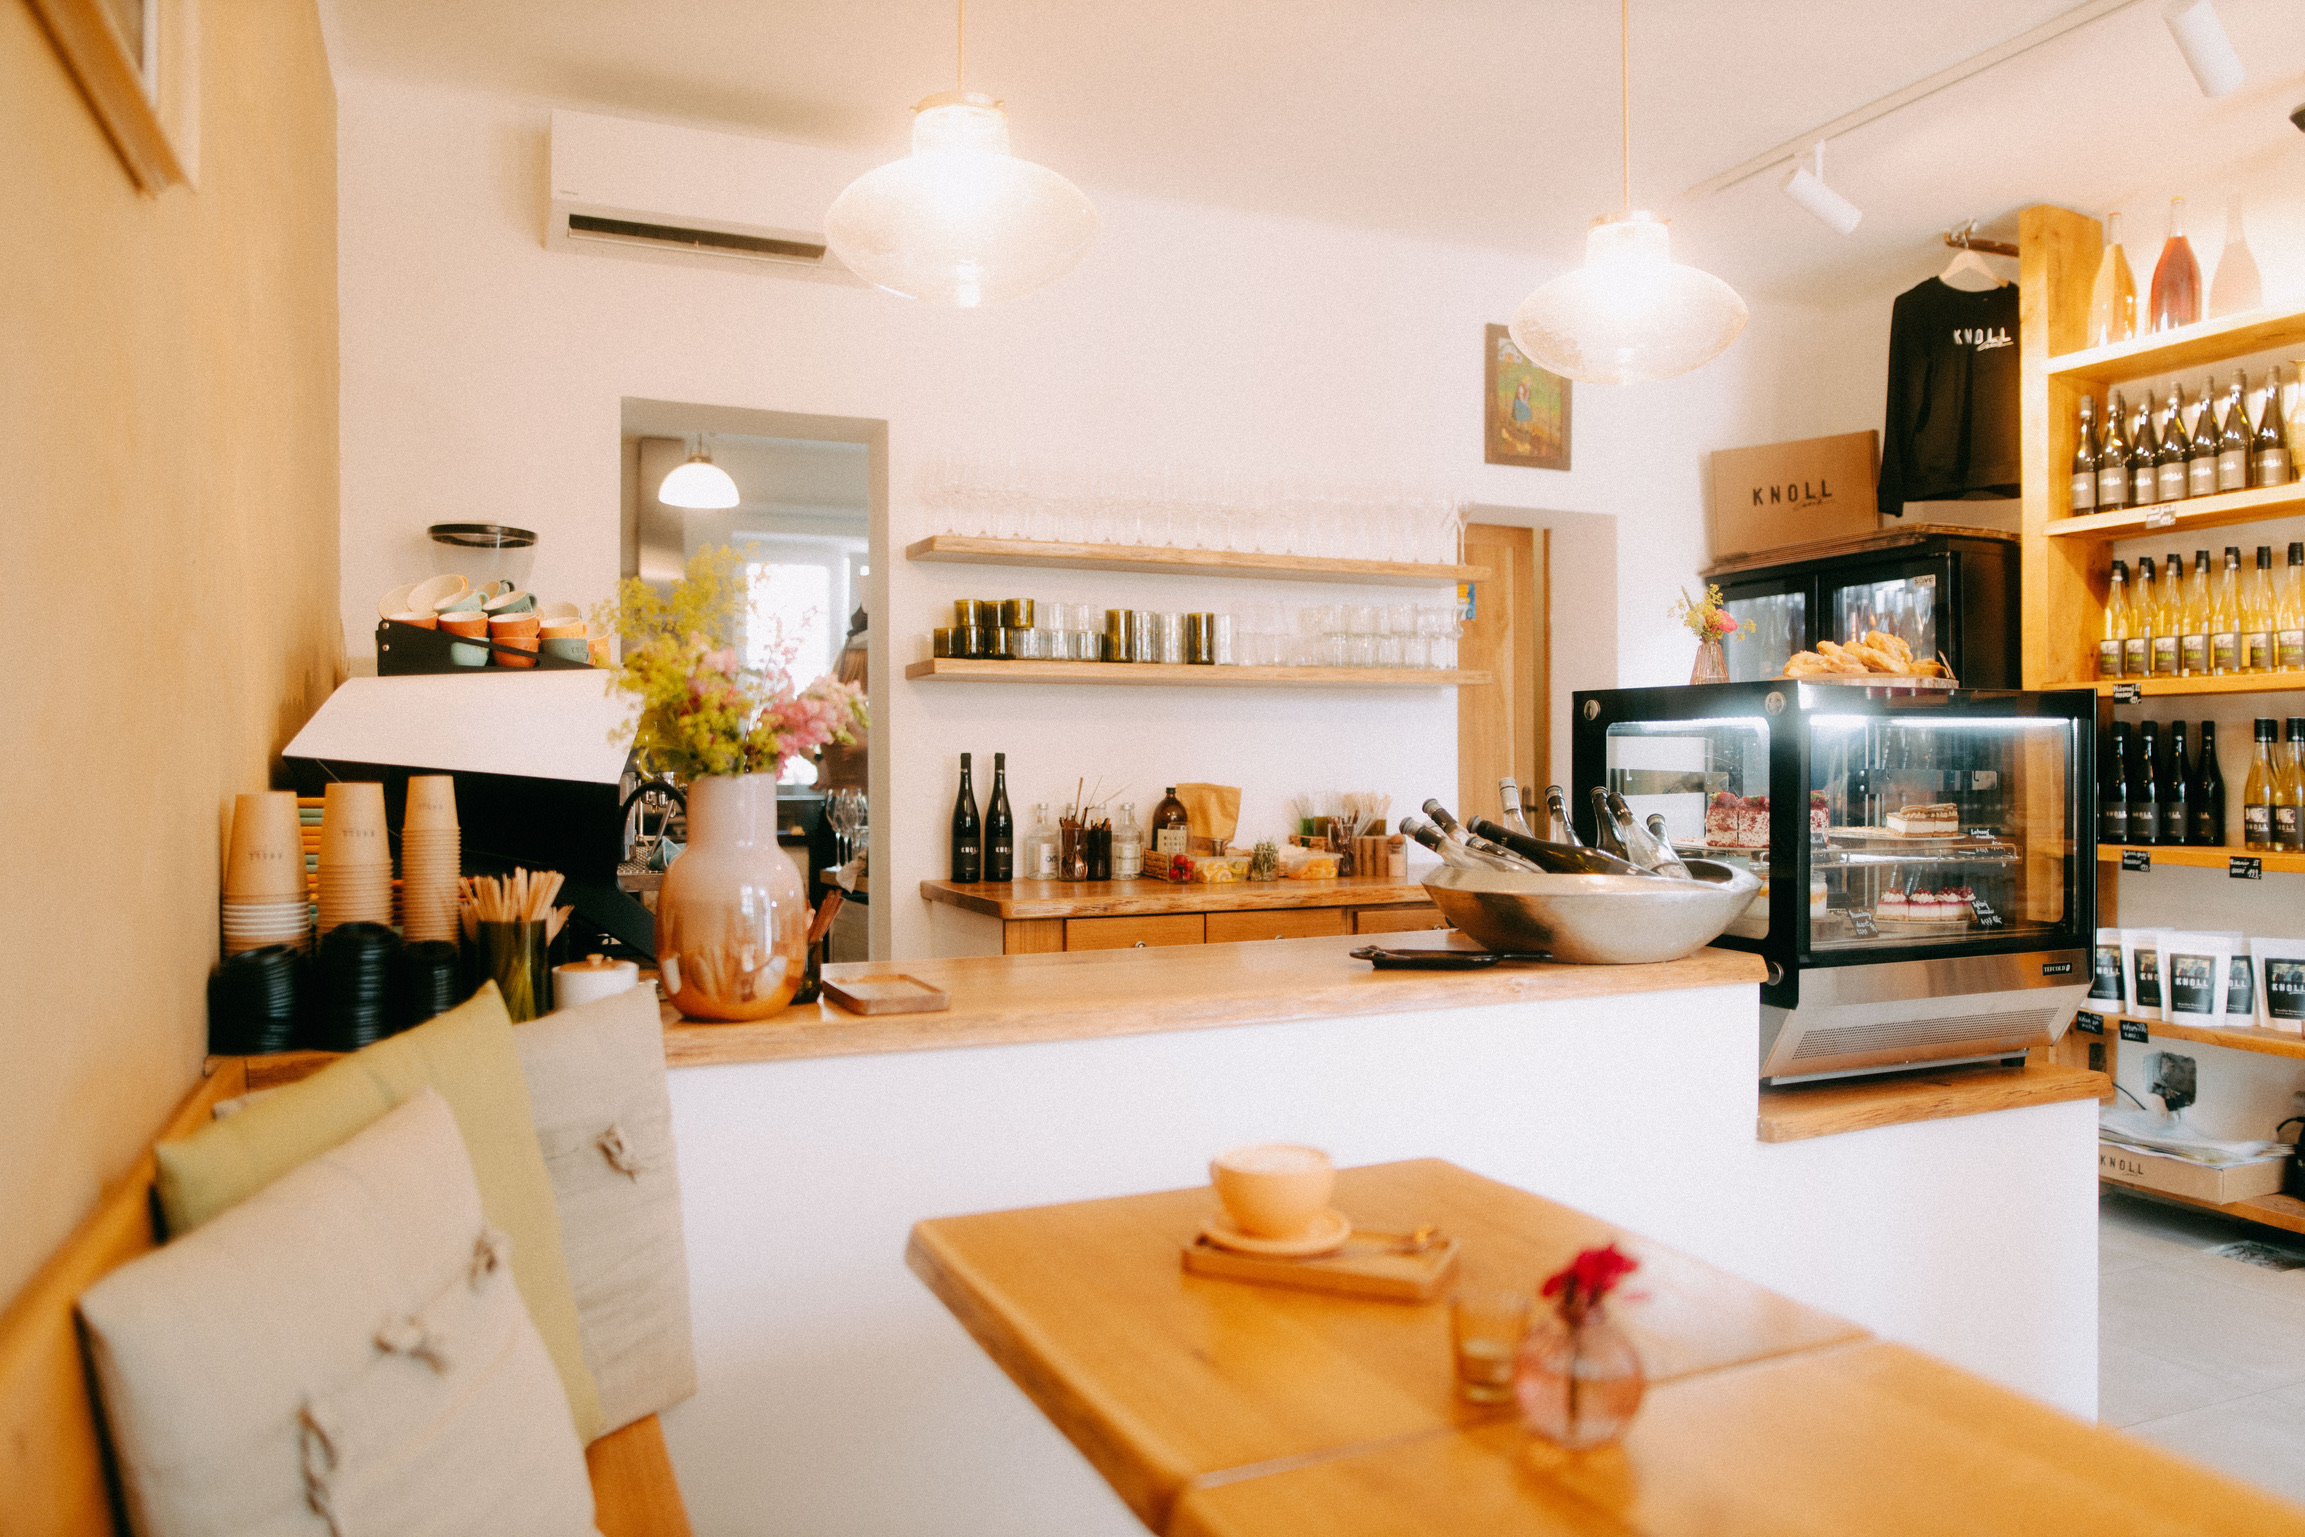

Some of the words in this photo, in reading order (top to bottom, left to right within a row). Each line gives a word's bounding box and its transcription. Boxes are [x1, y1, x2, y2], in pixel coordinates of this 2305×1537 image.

[1953, 327, 2012, 345] KNOLL
[1753, 480, 1832, 506] KNOLL
[2174, 977, 2208, 987] KNOLL
[2101, 1155, 2144, 1175] KNOLL
